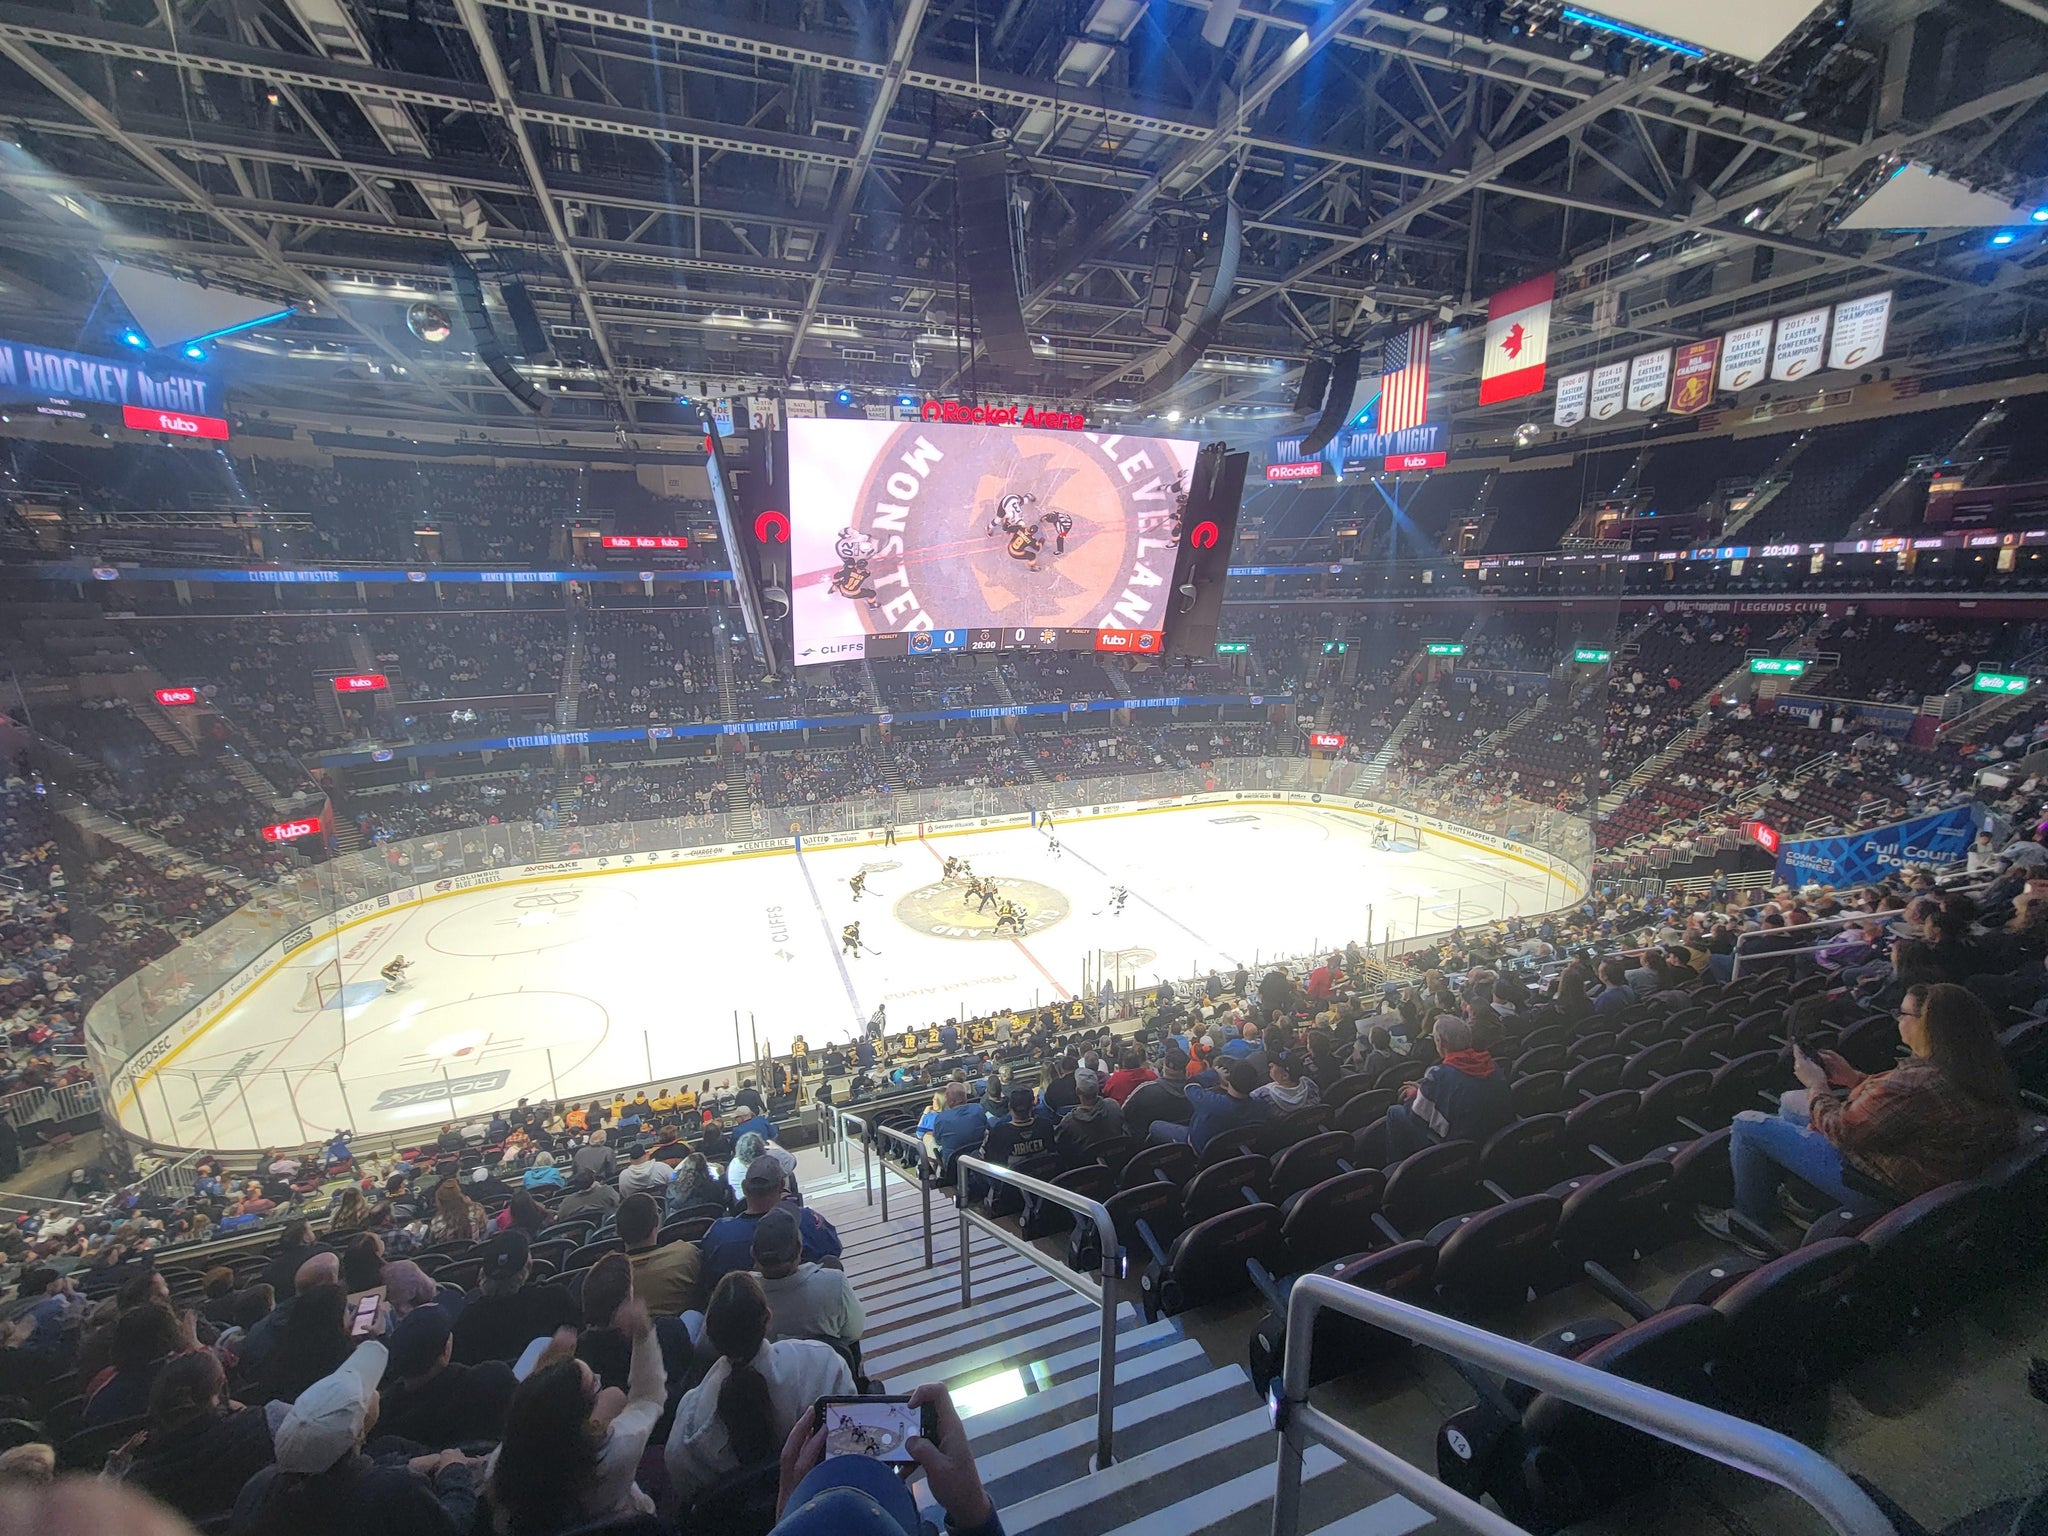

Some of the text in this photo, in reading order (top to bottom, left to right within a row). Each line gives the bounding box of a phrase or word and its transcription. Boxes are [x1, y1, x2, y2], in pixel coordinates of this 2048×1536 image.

[1838, 305, 1884, 323] CHAMPIONS
[1785, 315, 1820, 330] 2017-18
[1785, 327, 1816, 341] EASTERN
[1731, 340, 1760, 352] EASTERN
[1777, 334, 1822, 351] CONFERENCE
[1725, 347, 1765, 362] CONFERENCE
[1777, 345, 1818, 360] CHAMPIONS
[1638, 365, 1662, 376] EASTERN
[1725, 357, 1762, 371] CHAMPIONS
[0, 345, 207, 415] N HOCKEY NIGHT
[1633, 371, 1666, 385] CONFERENCE
[1633, 380, 1663, 393] CHAMPIONS
[943, 402, 1085, 430] Rocket Arena
[159, 415, 198, 432] fubo
[1326, 436, 1338, 459] IN
[1396, 427, 1438, 452] NIGHT
[1404, 457, 1426, 467] fubo
[1280, 464, 1318, 477] Rocket
[612, 538, 631, 547] fubo
[637, 538, 655, 547] fubo
[661, 538, 679, 547] fubo
[1914, 539, 1942, 548] SHOTS
[1762, 544, 1799, 556] 20:00
[1741, 602, 1792, 612] LEGENDS
[944, 630, 955, 644] 0
[1015, 628, 1025, 642] 0
[1102, 634, 1126, 646] fubo
[821, 643, 864, 655] CLIFFS
[972, 640, 996, 650] 20:00
[350, 678, 372, 687] fubo
[162, 692, 190, 702] fubo
[970, 707, 1000, 718] CLEVELAND
[755, 721, 778, 732] HOCKEY
[779, 719, 798, 730] NIGHT
[507, 732, 589, 748] CLEVELAND MONSTERS
[1318, 737, 1338, 746] fubo
[275, 823, 310, 840] fubo
[1757, 825, 1773, 848] fubo
[743, 839, 790, 850] CENTER ICE
[1502, 841, 1522, 854] WM
[1864, 841, 1958, 861] Full Court
[1786, 850, 1837, 867] COMCAST
[1785, 858, 1835, 874] BUSINESS
[454, 870, 500, 883] COLUMBUS
[456, 875, 502, 889] BLUE JACKETS
[766, 905, 790, 943] CLIFFS
[116, 1035, 172, 1095] TRSTEDSEC
